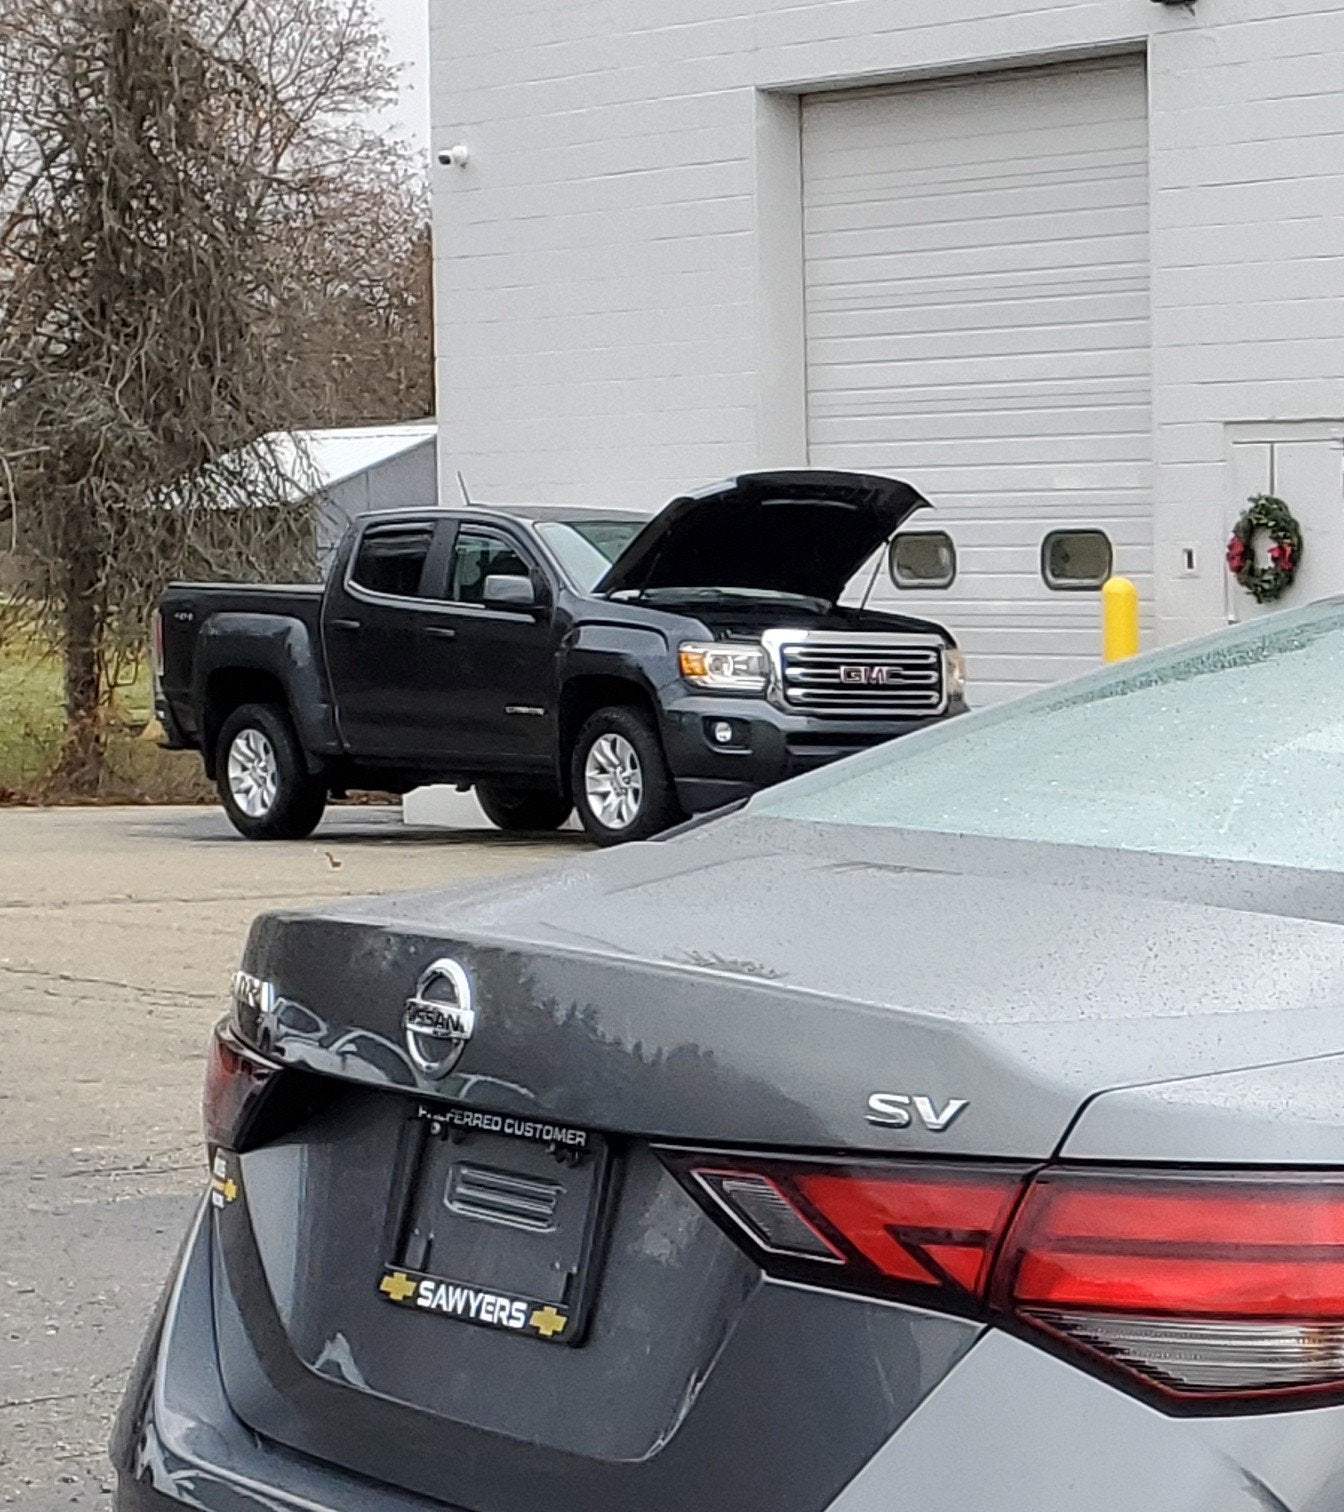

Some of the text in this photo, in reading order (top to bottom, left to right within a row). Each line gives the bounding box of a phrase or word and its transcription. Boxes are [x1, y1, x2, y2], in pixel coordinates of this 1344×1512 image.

[840, 666, 904, 685] GMC
[418, 1104, 587, 1147] PFERRED CUSTOMER
[863, 1093, 970, 1132] SV
[416, 1280, 528, 1329] SAWYERS
